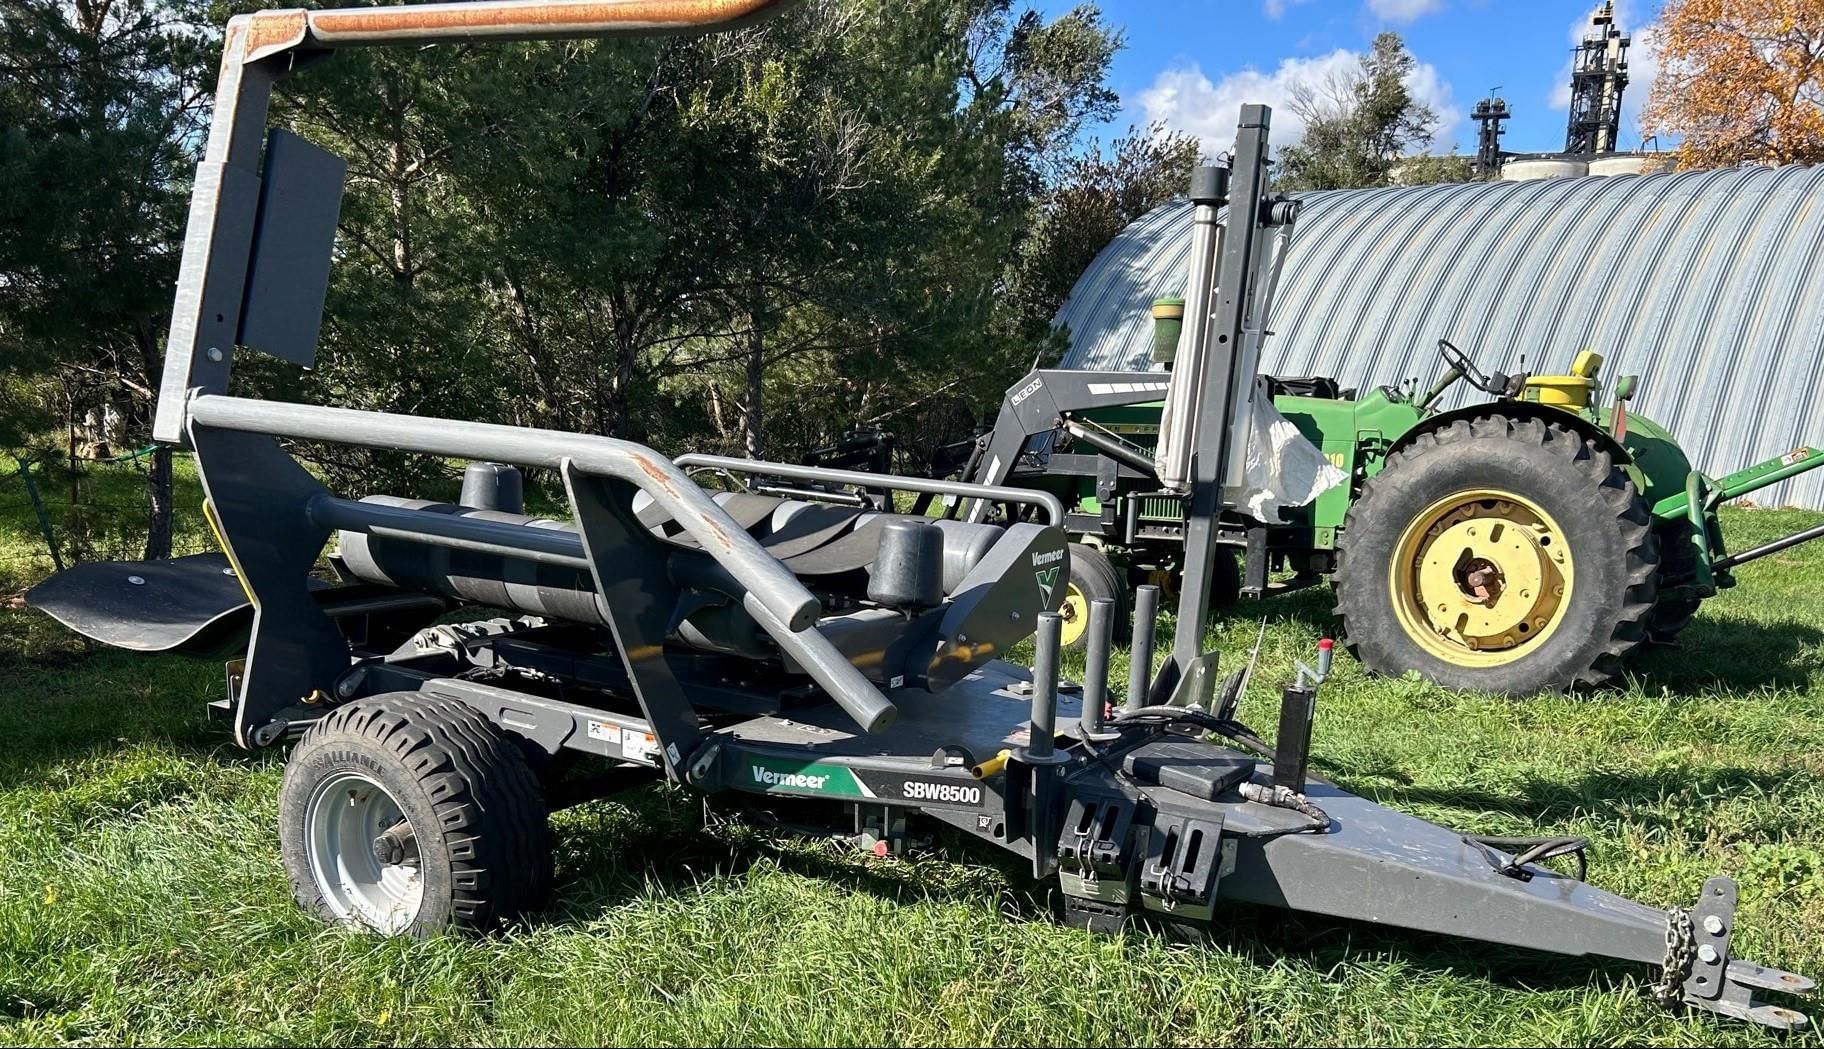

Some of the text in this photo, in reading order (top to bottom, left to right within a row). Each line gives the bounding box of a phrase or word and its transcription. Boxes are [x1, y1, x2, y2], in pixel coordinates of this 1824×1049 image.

[1011, 377, 1042, 405] LEON
[1032, 549, 1063, 566] Vermeer
[323, 751, 385, 777] ALLIANCE
[752, 765, 826, 789] Vermeer
[903, 781, 980, 803] SBW8500
